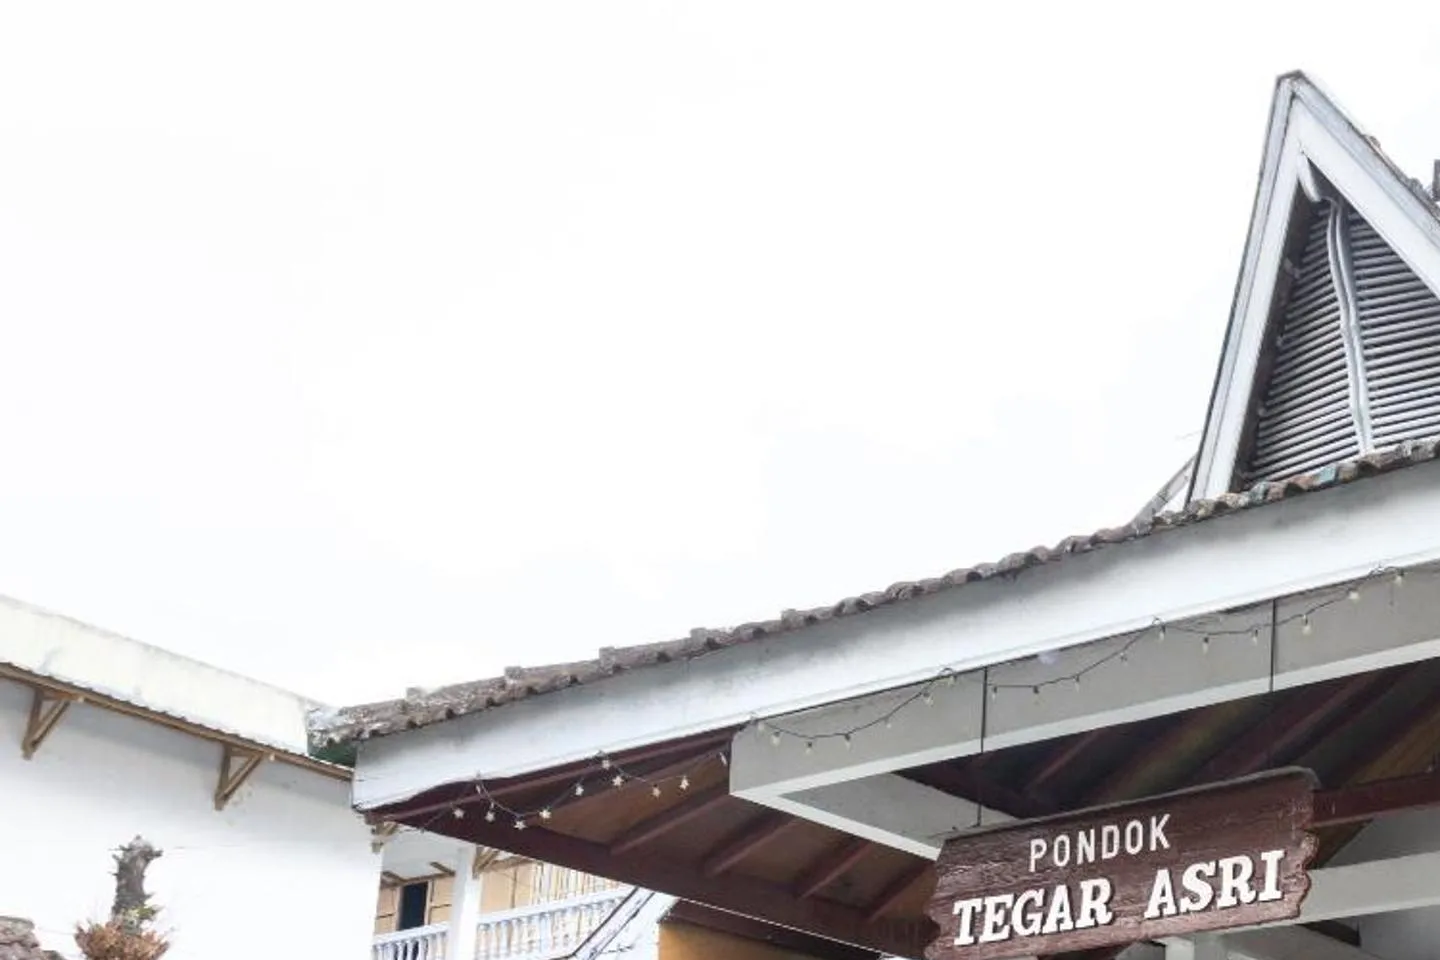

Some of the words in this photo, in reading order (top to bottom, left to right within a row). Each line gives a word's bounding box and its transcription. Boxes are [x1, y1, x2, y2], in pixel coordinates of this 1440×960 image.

[1029, 813, 1171, 873] PONDOK
[953, 878, 1114, 946] TEGAR
[1143, 849, 1285, 920] ASRI
